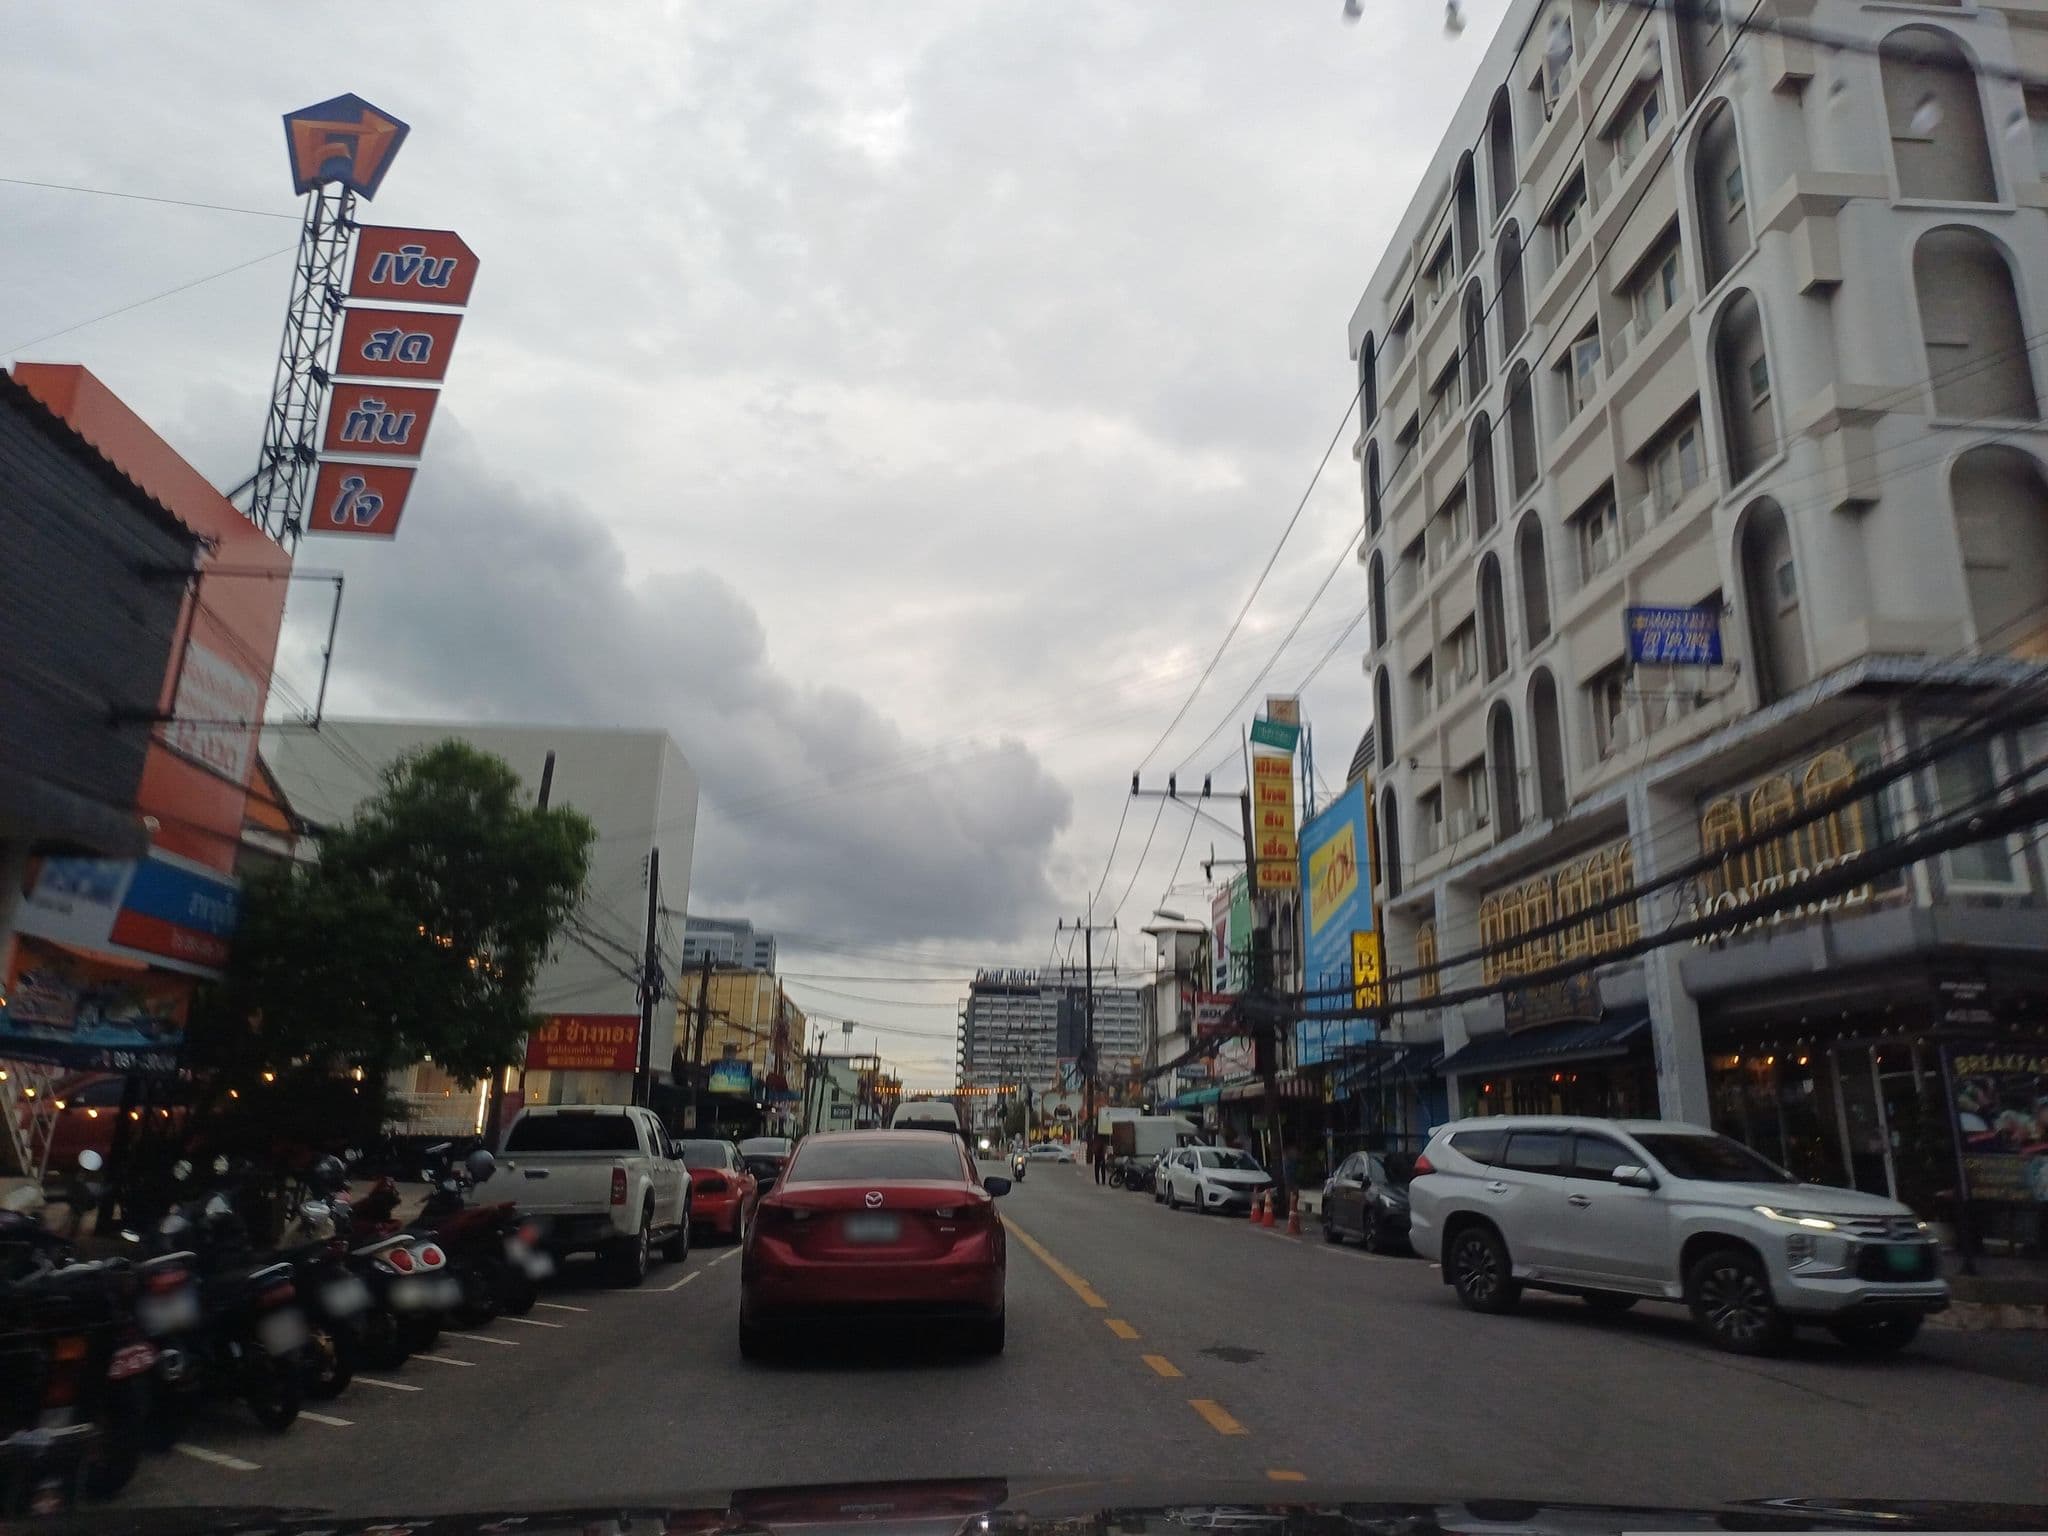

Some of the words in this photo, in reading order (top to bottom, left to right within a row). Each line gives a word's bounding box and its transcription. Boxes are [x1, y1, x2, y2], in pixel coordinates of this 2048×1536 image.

[369, 244, 458, 288] เงิน
[361, 328, 434, 364] สด
[340, 399, 416, 445] ทัน
[331, 476, 384, 526] ใจ
